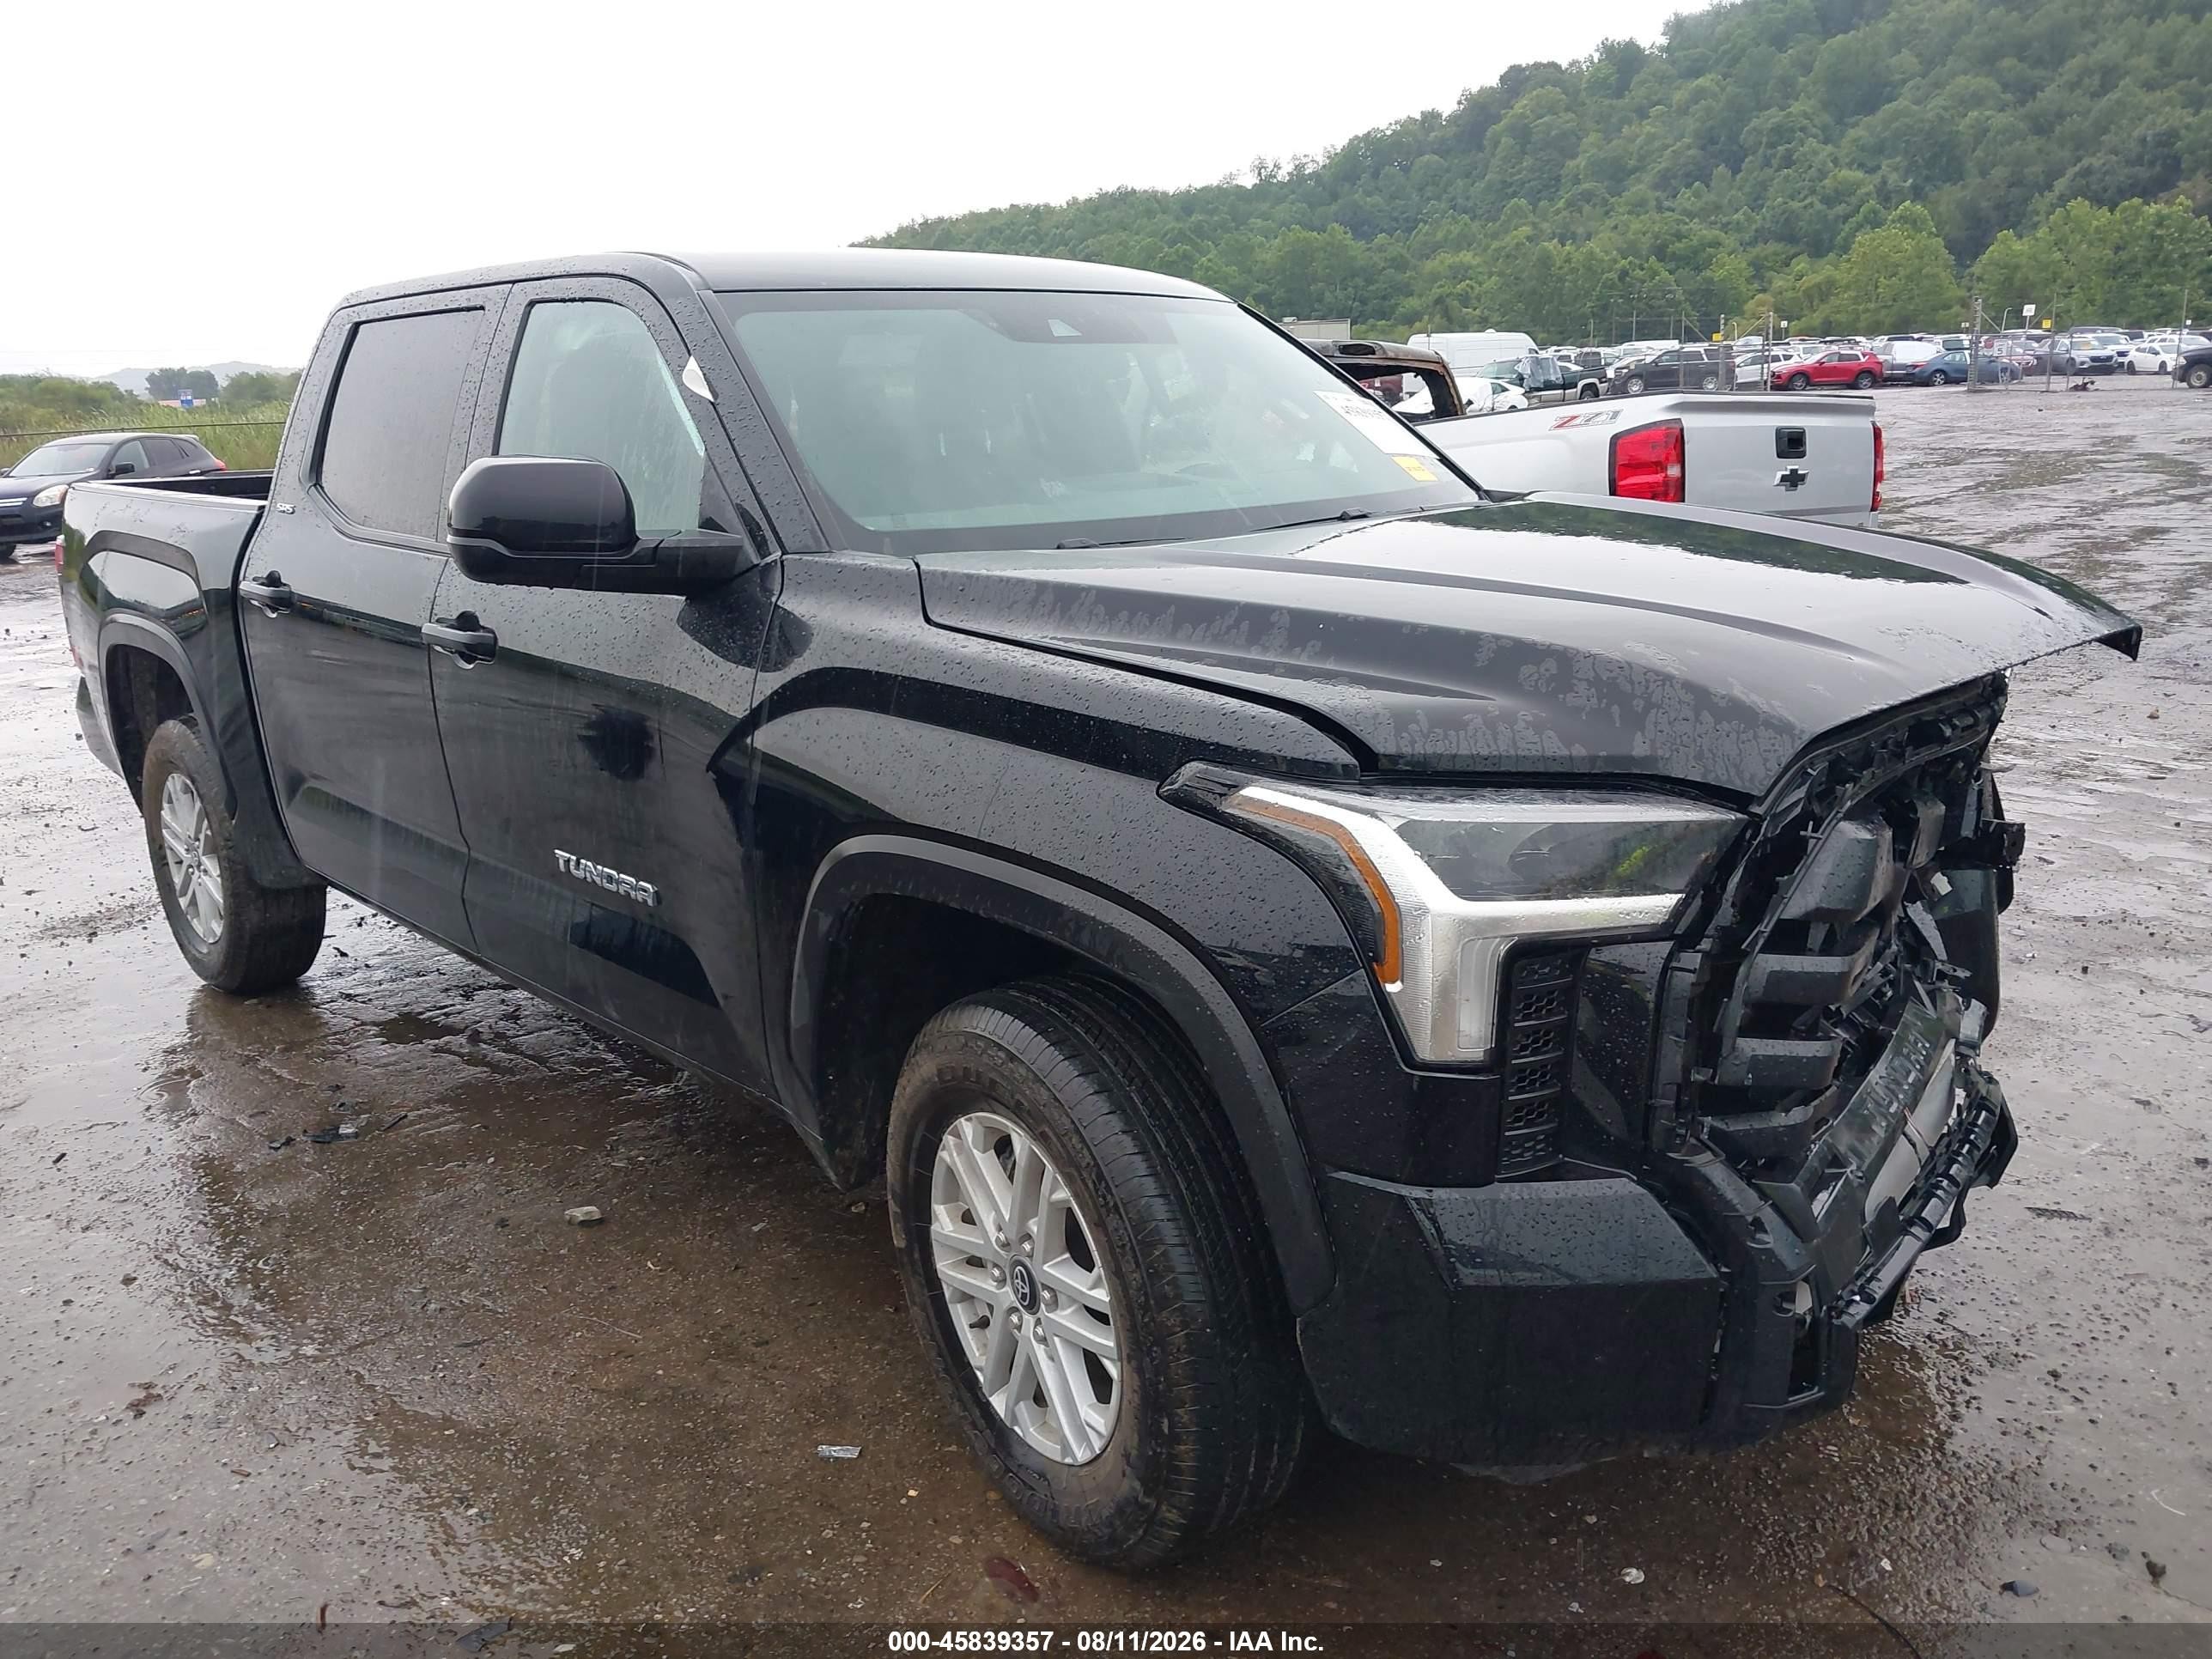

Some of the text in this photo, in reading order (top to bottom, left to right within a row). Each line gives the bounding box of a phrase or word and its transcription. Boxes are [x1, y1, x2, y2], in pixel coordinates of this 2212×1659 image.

[1548, 409, 1624, 431] Z71
[553, 848, 660, 907] TUNDRA
[1863, 1030, 1930, 1127] TUNDRA
